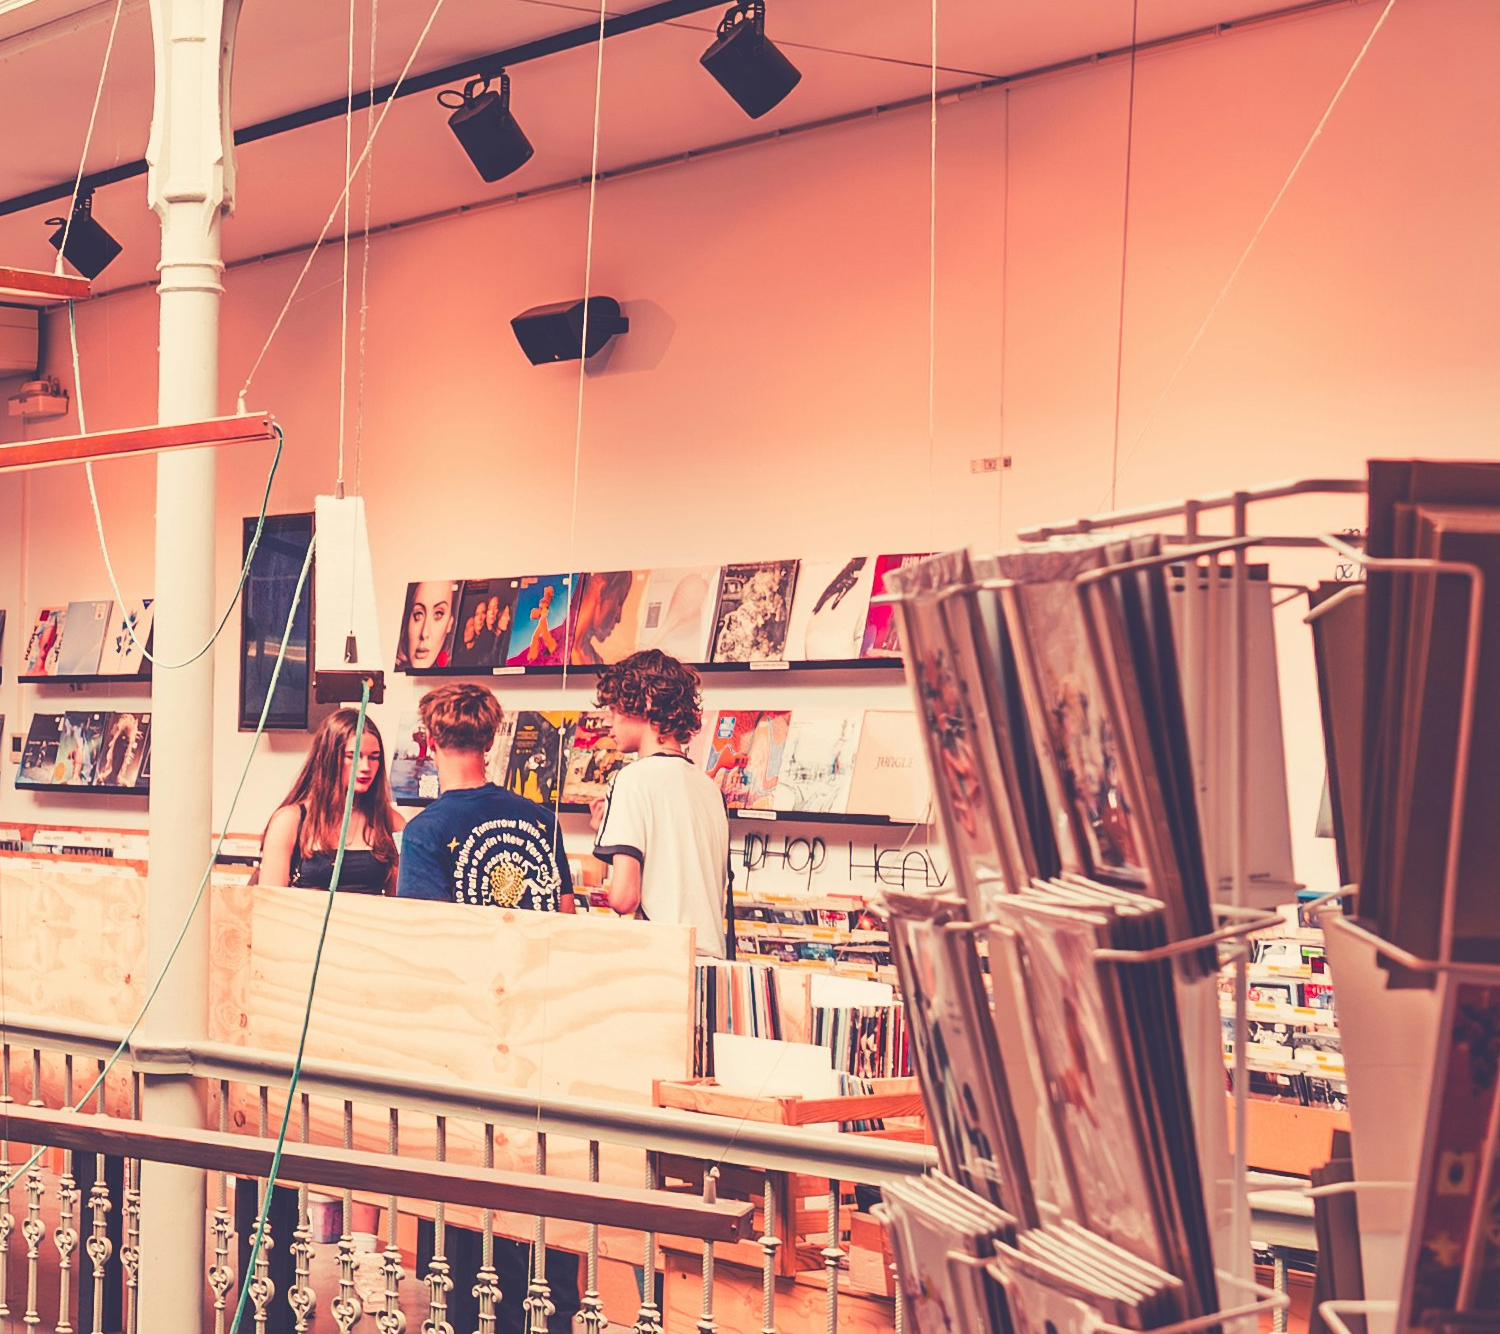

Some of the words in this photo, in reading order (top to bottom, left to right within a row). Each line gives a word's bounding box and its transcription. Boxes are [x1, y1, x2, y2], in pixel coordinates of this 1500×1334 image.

[472, 818, 517, 837] Tomorrow
[502, 832, 525, 847] New
[849, 840, 950, 891] HEAV
